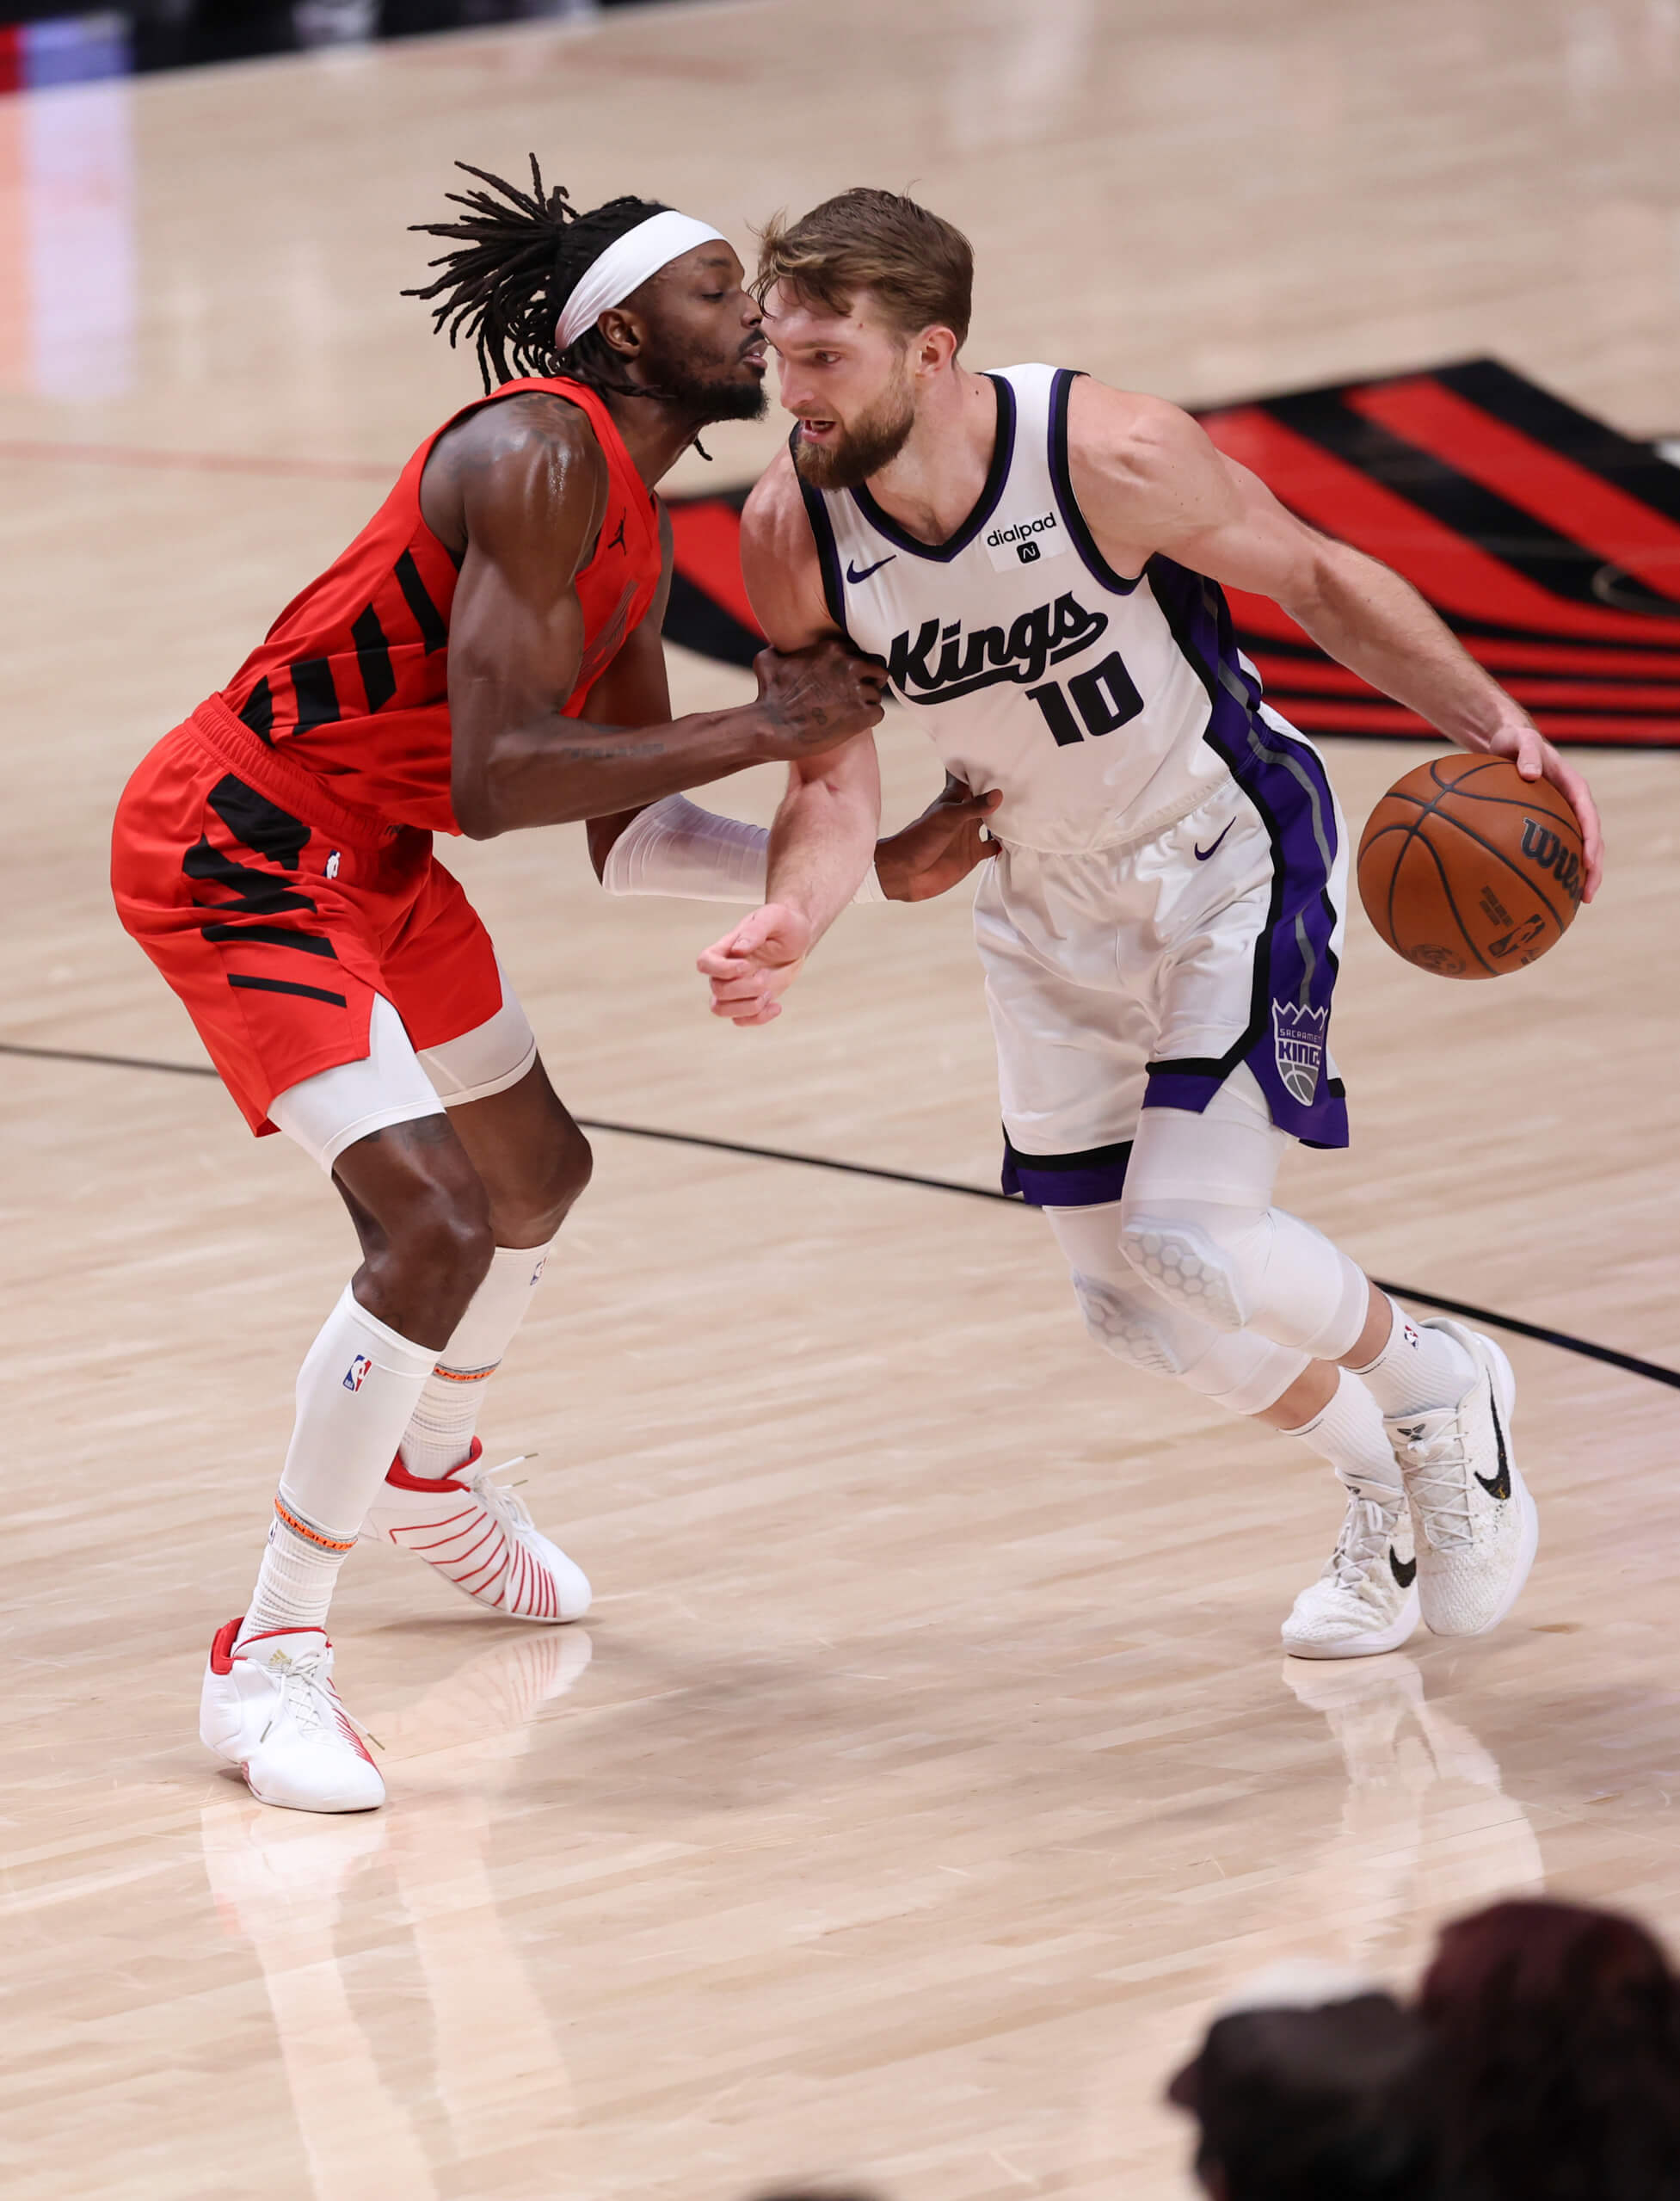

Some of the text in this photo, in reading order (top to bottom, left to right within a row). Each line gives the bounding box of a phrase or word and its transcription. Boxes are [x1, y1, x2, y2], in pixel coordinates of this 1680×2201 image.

[987, 511, 1057, 547] dialpad
[889, 591, 1109, 706] Kings
[1025, 650, 1145, 748] 10
[1279, 1027, 1321, 1043] SACRAME
